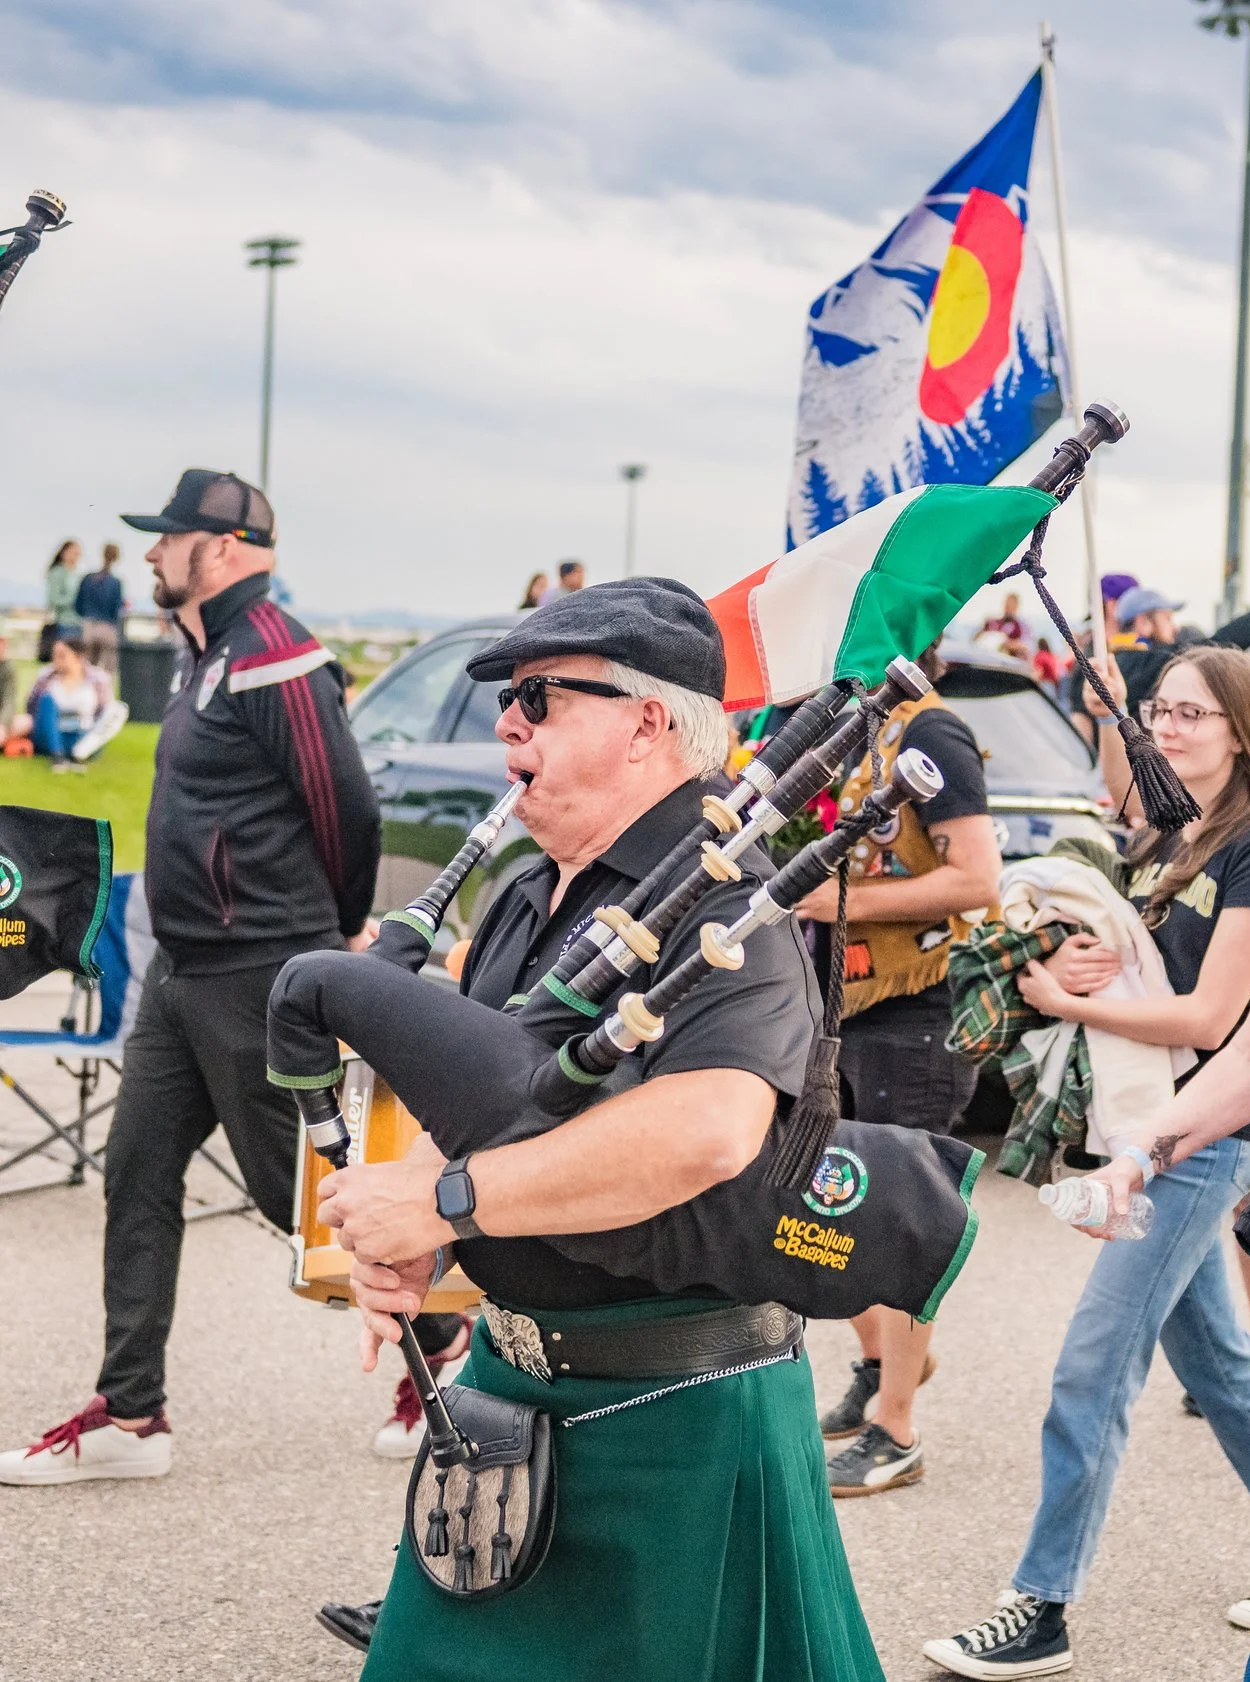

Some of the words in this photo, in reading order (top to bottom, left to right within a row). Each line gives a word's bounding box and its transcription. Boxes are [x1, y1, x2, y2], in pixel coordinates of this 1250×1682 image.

[0, 917, 26, 934] llum
[0, 932, 26, 948] ipes
[775, 1215, 855, 1254] McCallum
[784, 1236, 849, 1270] Bagpipes
